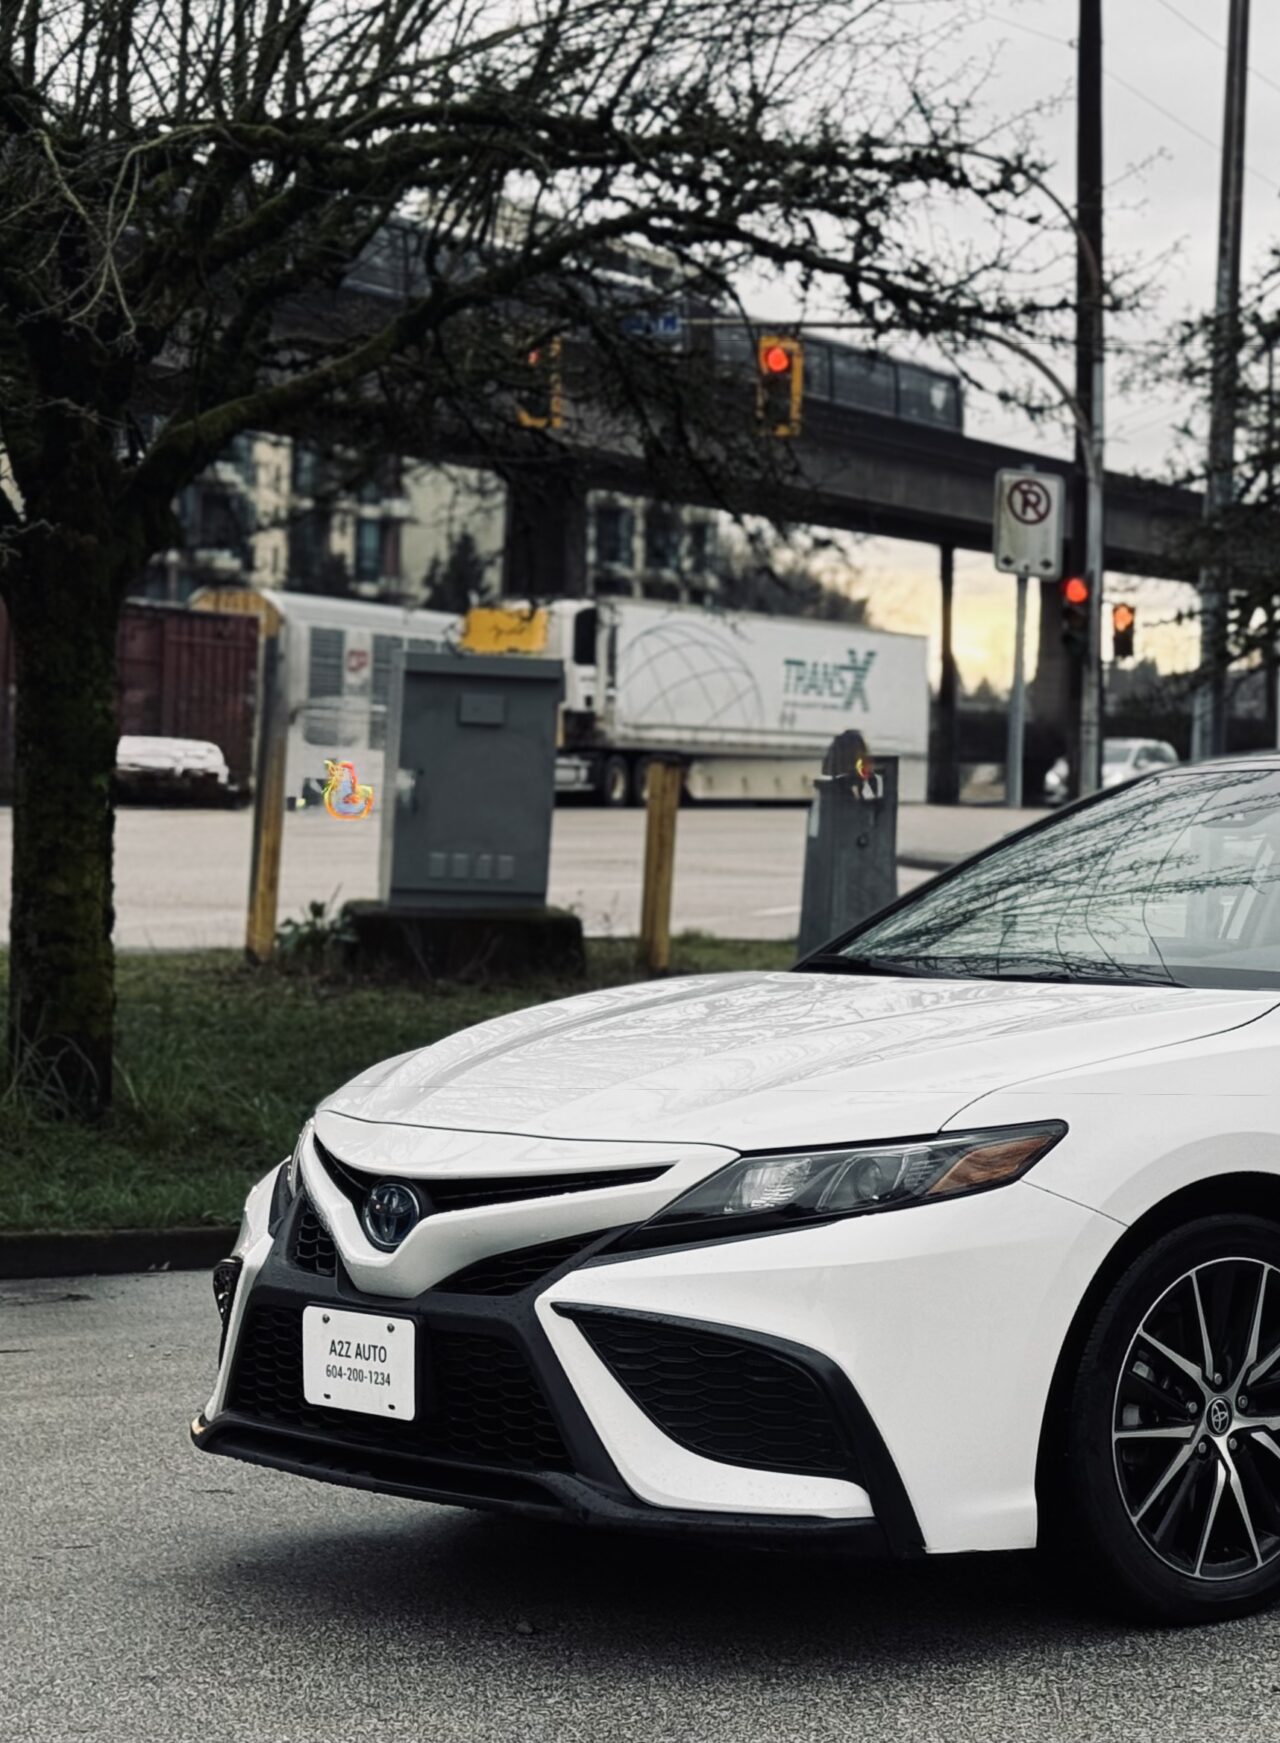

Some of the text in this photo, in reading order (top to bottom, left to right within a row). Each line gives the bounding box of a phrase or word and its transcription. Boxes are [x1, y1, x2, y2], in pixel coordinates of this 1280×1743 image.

[329, 1339, 387, 1363] A2Z AUTO
[326, 1364, 391, 1387] 604-200-1234
